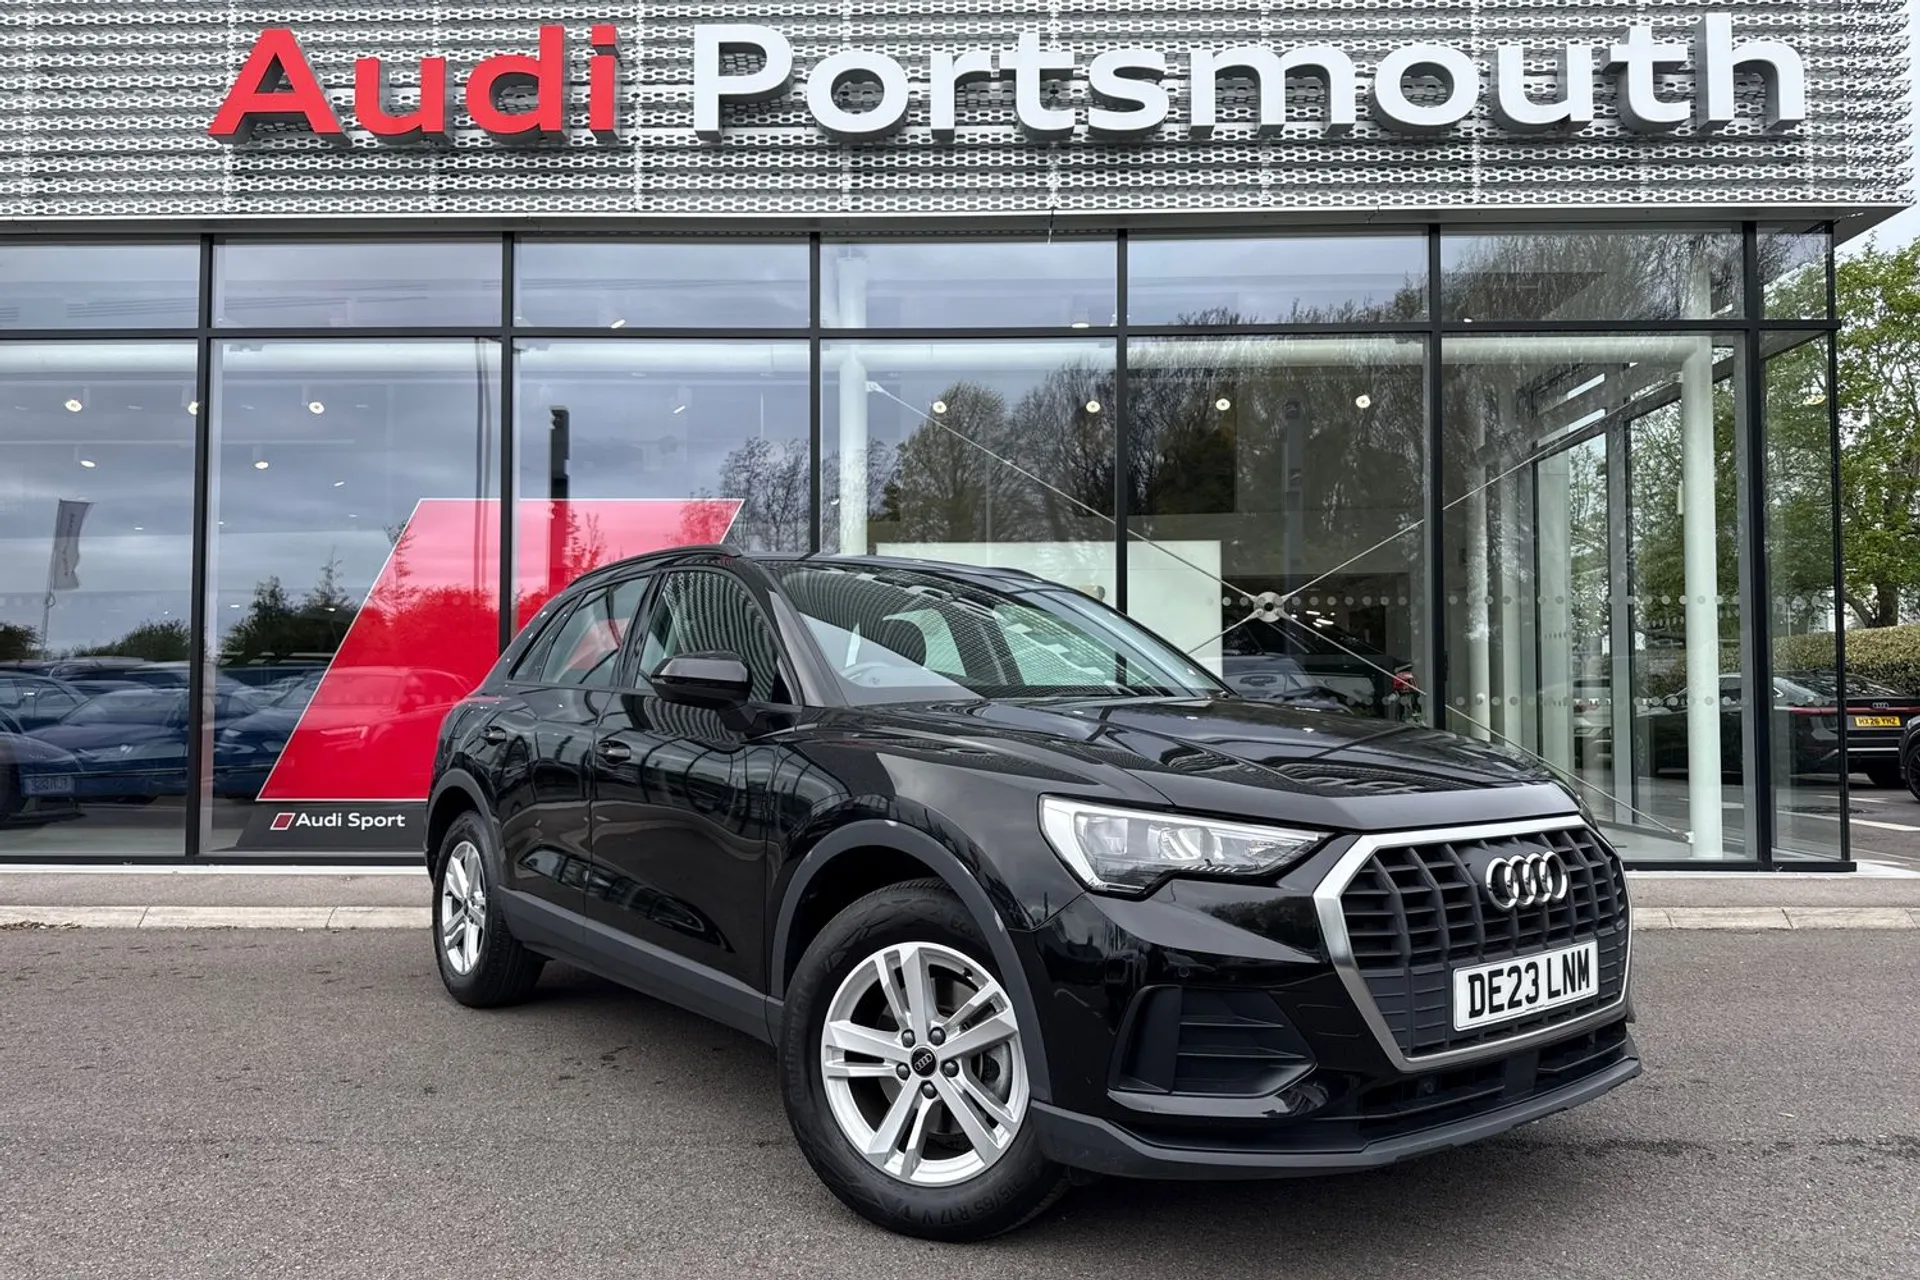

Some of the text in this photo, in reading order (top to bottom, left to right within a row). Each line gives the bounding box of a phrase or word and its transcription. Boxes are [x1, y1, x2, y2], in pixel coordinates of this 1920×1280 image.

[207, 13, 1803, 137] Audi Portsmouth
[295, 812, 406, 830] Audi Sport
[1468, 948, 1590, 1019] DE23 LNM
